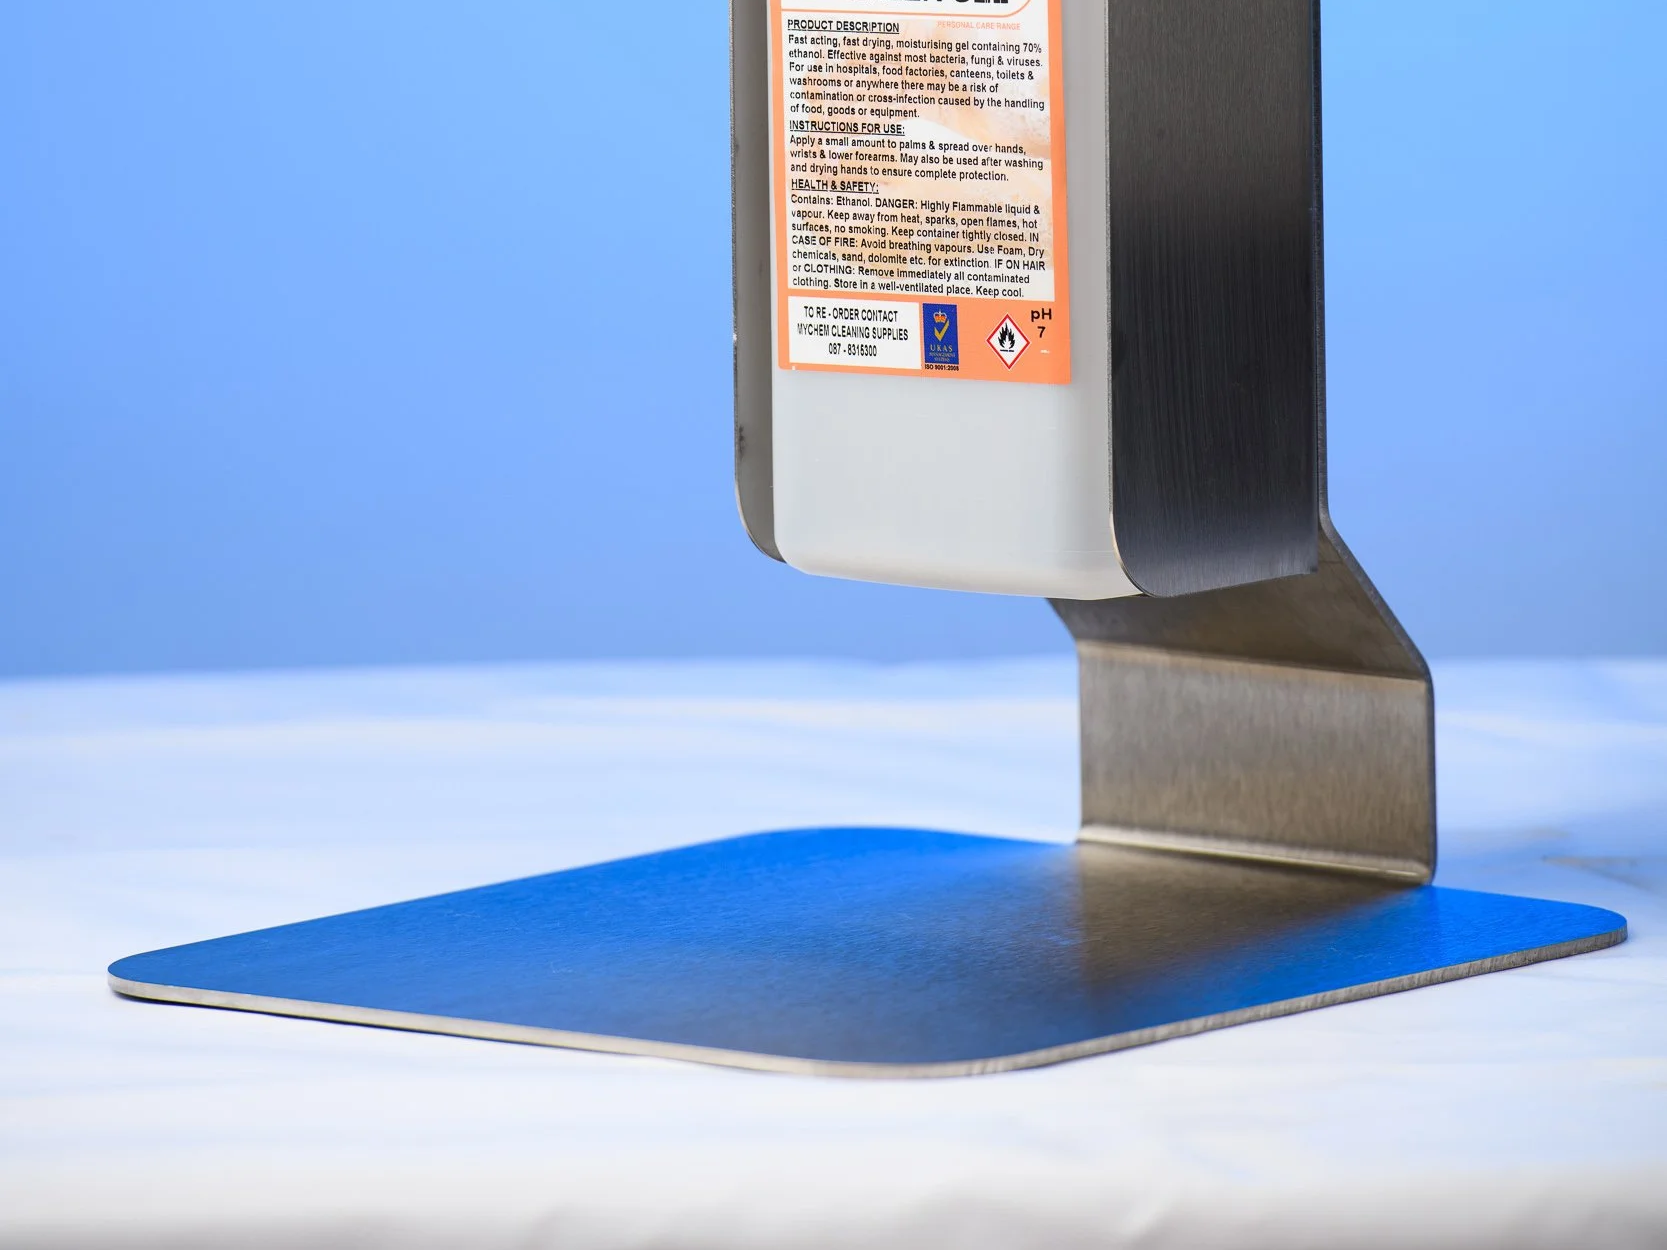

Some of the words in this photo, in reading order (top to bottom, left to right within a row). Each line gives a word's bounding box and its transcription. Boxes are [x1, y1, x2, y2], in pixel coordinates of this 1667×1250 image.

[787, 20, 834, 30] PRODUCT
[836, 21, 900, 32] DESCRIPTION
[788, 35, 808, 44] Fast
[810, 36, 840, 48] acting,
[842, 36, 860, 46] fast
[862, 37, 894, 50] drying,
[896, 39, 953, 52] moisturising
[955, 41, 969, 52] gel
[971, 42, 1020, 54] containing
[1022, 44, 1042, 53] 70%
[788, 49, 825, 58] ethanol.
[827, 50, 867, 60] Effective
[869, 52, 902, 63] against
[904, 53, 927, 62] most
[929, 54, 968, 66] bacteria,
[970, 55, 995, 67] fungi
[997, 56, 1004, 65] &
[1006, 57, 1043, 67] viruses.
[789, 62, 804, 71] For
[825, 64, 834, 72] in
[836, 64, 880, 76] hospitals,
[882, 66, 903, 75] food
[905, 66, 948, 79] factories,
[950, 69, 994, 80] canteens,
[996, 70, 1025, 80] toilets
[1027, 71, 1034, 80] &
[789, 76, 842, 86] washrooms
[856, 79, 899, 90] anywhere
[901, 80, 924, 90] there
[926, 83, 946, 93] may
[948, 82, 960, 91] be
[970, 83, 987, 92] risk
[989, 84, 999, 93] of
[790, 90, 854, 101] contamination
[868, 94, 936, 104] cross-infection
[938, 97, 971, 106] caused
[973, 97, 985, 109] by
[986, 98, 1002, 107] the
[1004, 98, 1045, 111] handling
[790, 104, 800, 112] of
[801, 104, 825, 115] food,
[827, 106, 856, 116] goods
[870, 107, 920, 119] equipment.
[789, 121, 859, 132] INSTRUCTIONS
[861, 123, 881, 133] FOR
[883, 124, 905, 134] USE:
[790, 135, 816, 147] Apply
[825, 137, 849, 146] small
[851, 139, 885, 148] amount
[887, 139, 897, 148] to
[899, 140, 926, 151] palms
[928, 141, 936, 150] &
[938, 142, 970, 153] spread
[972, 144, 992, 152] over
[995, 144, 1026, 155] hands,
[790, 149, 817, 158] wrists
[819, 150, 826, 159] &
[828, 150, 853, 160] lower
[855, 151, 898, 162] forearms.
[900, 153, 919, 165] May
[920, 154, 940, 164] also
[942, 155, 954, 164] be
[956, 156, 979, 165] used
[981, 157, 1002, 166] after
[1004, 159, 1043, 171] washing
[790, 163, 807, 172] and
[810, 163, 838, 176] drying
[840, 165, 868, 174] hands
[870, 166, 880, 175] to
[881, 168, 912, 176] ensure
[914, 169, 956, 180] complete
[959, 170, 1009, 182] protection.
[791, 179, 828, 189] HEALTH
[830, 180, 838, 190] &
[839, 182, 878, 192] SAFETY:
[790, 194, 834, 205] Contains:
[836, 196, 872, 207] Ethanol.
[875, 198, 918, 209] DANGER:
[920, 200, 950, 213] Highly
[952, 202, 1003, 213] Flammable
[1005, 204, 1031, 216] liquid
[1033, 206, 1040, 214] &
[791, 210, 825, 220] vapour.
[827, 210, 850, 222] Keep
[852, 213, 875, 223] away
[877, 212, 898, 222] from
[900, 213, 922, 225] heat,
[925, 215, 958, 226] sparks,
[960, 218, 984, 228] open
[986, 217, 1020, 229] flames,
[1022, 219, 1038, 228] hot
[792, 222, 832, 234] surfaces,
[848, 225, 889, 237] smoking.
[891, 226, 915, 239] Keep
[916, 228, 960, 238] container
[962, 230, 992, 242] tightly
[993, 232, 1027, 242] closed.
[1029, 233, 1039, 242] IN
[792, 236, 817, 245] CASE
[818, 237, 832, 246] OF
[834, 238, 858, 247] FIRE:
[860, 239, 886, 249] Avoid
[888, 240, 932, 254] breathing
[934, 244, 974, 254] vapours.
[977, 244, 995, 254] Use
[997, 245, 1026, 257] Foam,
[1028, 247, 1045, 259] Dry
[792, 249, 839, 262] chemicals,
[842, 252, 866, 263] sand,
[868, 253, 907, 264] dolomite
[909, 255, 926, 265] etc.
[928, 256, 942, 266] for
[994, 260, 1003, 269] IF
[1006, 260, 1020, 270] ON
[1022, 261, 1046, 271] HAIR
[804, 263, 855, 274] CLOTHING:
[858, 266, 894, 276] Remove
[896, 268, 952, 282] immediately
[954, 271, 965, 280] all
[967, 273, 1030, 284] contaminated
[792, 276, 832, 290] clothing.
[834, 278, 858, 288] Store
[860, 280, 868, 289] in
[878, 281, 944, 293] well-ventilated
[946, 285, 973, 296] place.
[976, 286, 1000, 298] Keep
[1001, 288, 1024, 297] cool.
[816, 306, 826, 320] RE
[832, 307, 860, 322] ORDER
[861, 309, 898, 324] CONTACT
[1031, 308, 1052, 322] pH
[831, 324, 870, 340] CLEANING
[872, 326, 908, 342] SUPPLIES
[1037, 326, 1046, 338] 7
[828, 342, 841, 356] 087
